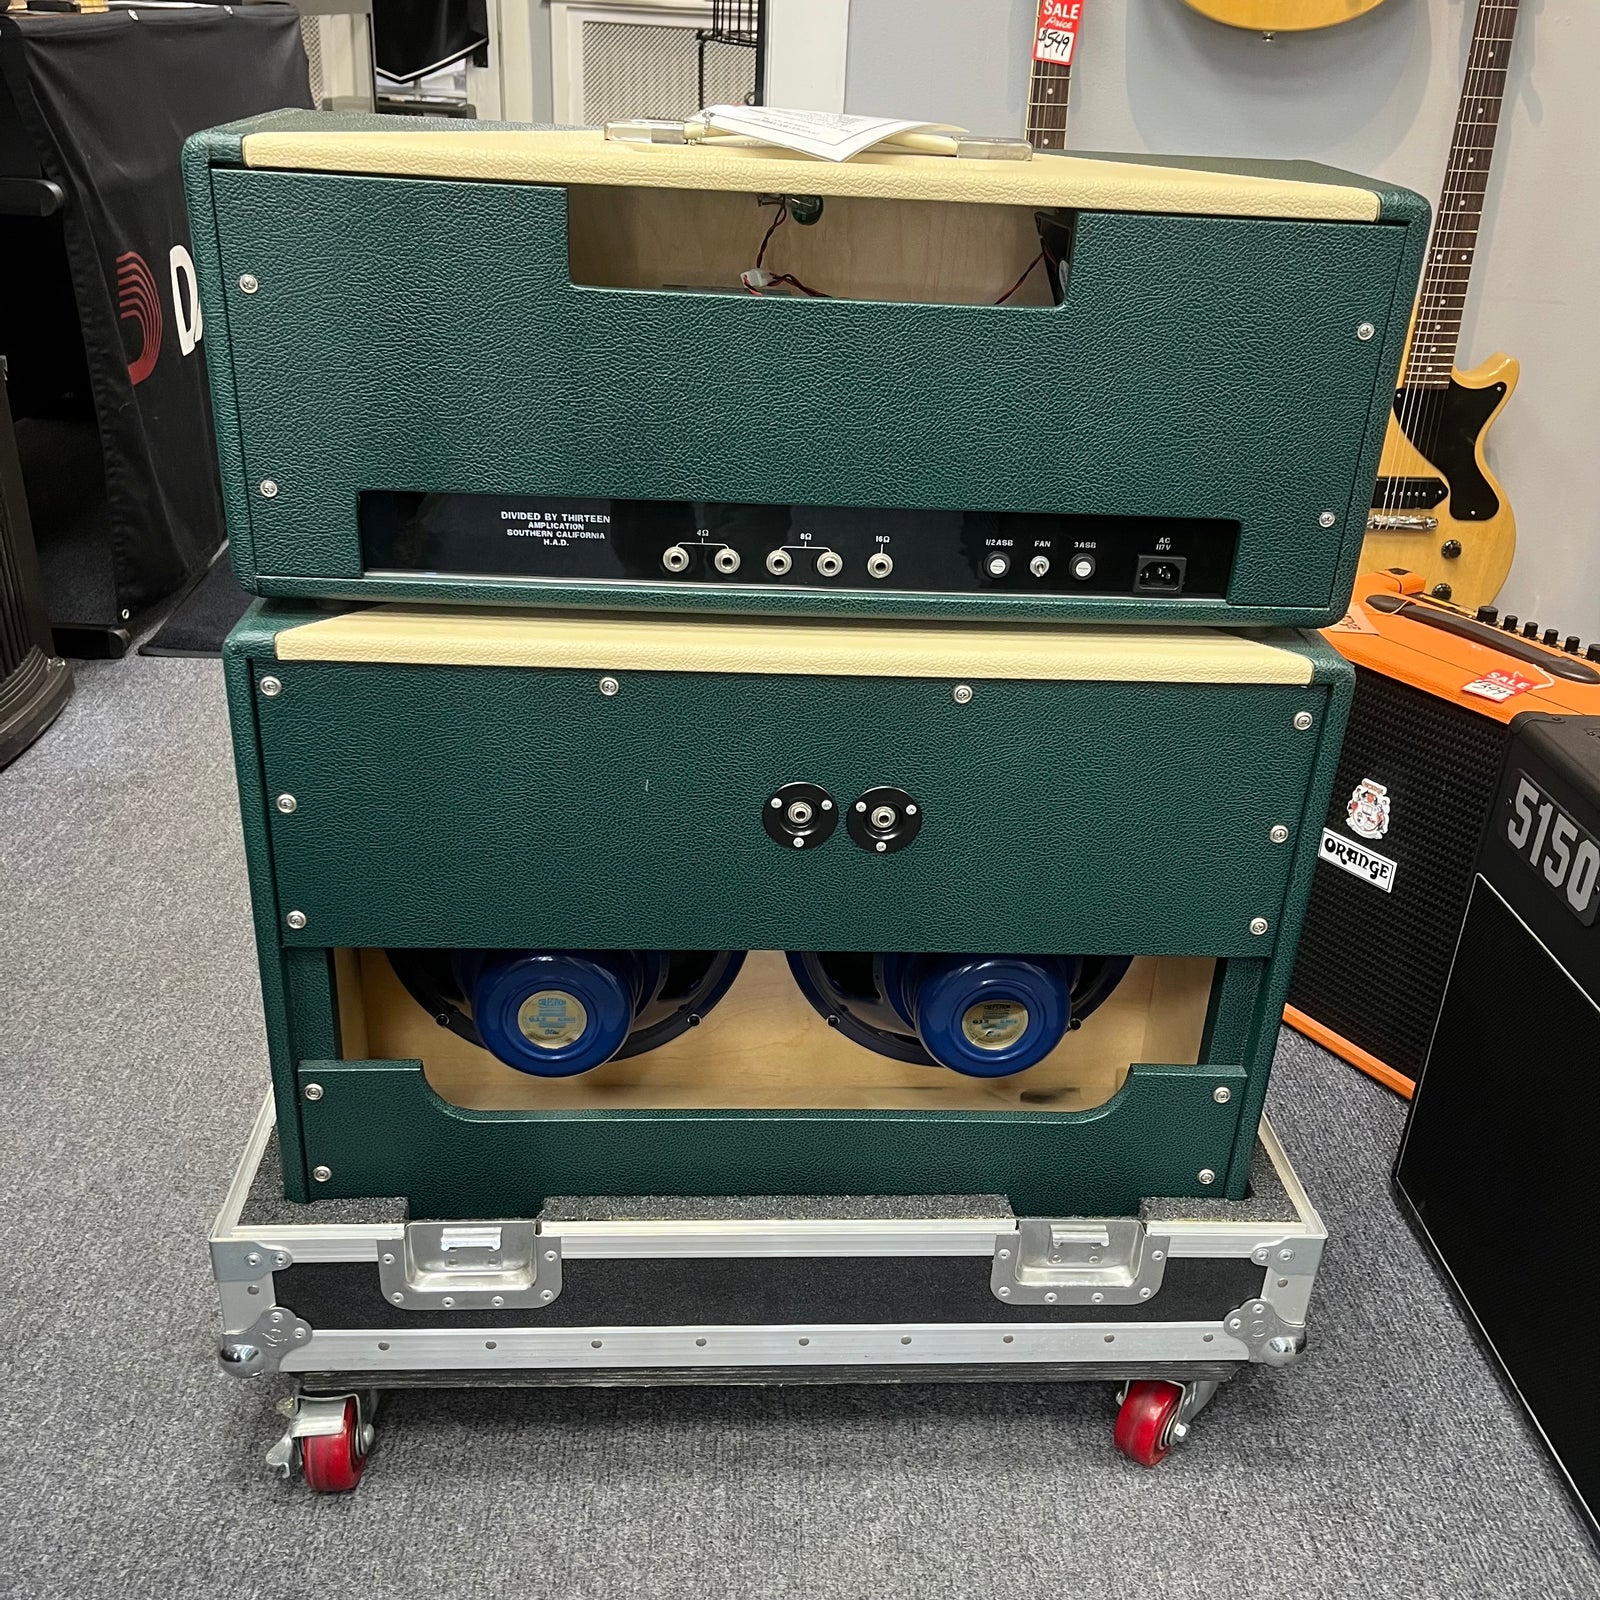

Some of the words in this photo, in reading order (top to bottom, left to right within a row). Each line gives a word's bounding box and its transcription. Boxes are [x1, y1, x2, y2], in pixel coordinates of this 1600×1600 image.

[1044, 0, 1080, 19] SALE
[1044, 17, 1073, 30] Price
[1038, 29, 1070, 56] $549
[500, 511, 541, 520] DIVIDED
[544, 513, 558, 521] BY
[561, 514, 611, 523] THIRTEEN
[528, 522, 584, 530] AMPLICATION
[507, 529, 553, 537] SOUTHERN
[556, 531, 605, 539] CALIFORNIA
[876, 535, 890, 543] 16Ω
[1034, 540, 1051, 548] FAN
[1487, 672, 1530, 689] SALE
[1508, 778, 1600, 912] 5150
[1324, 838, 1390, 880] ORANGE
